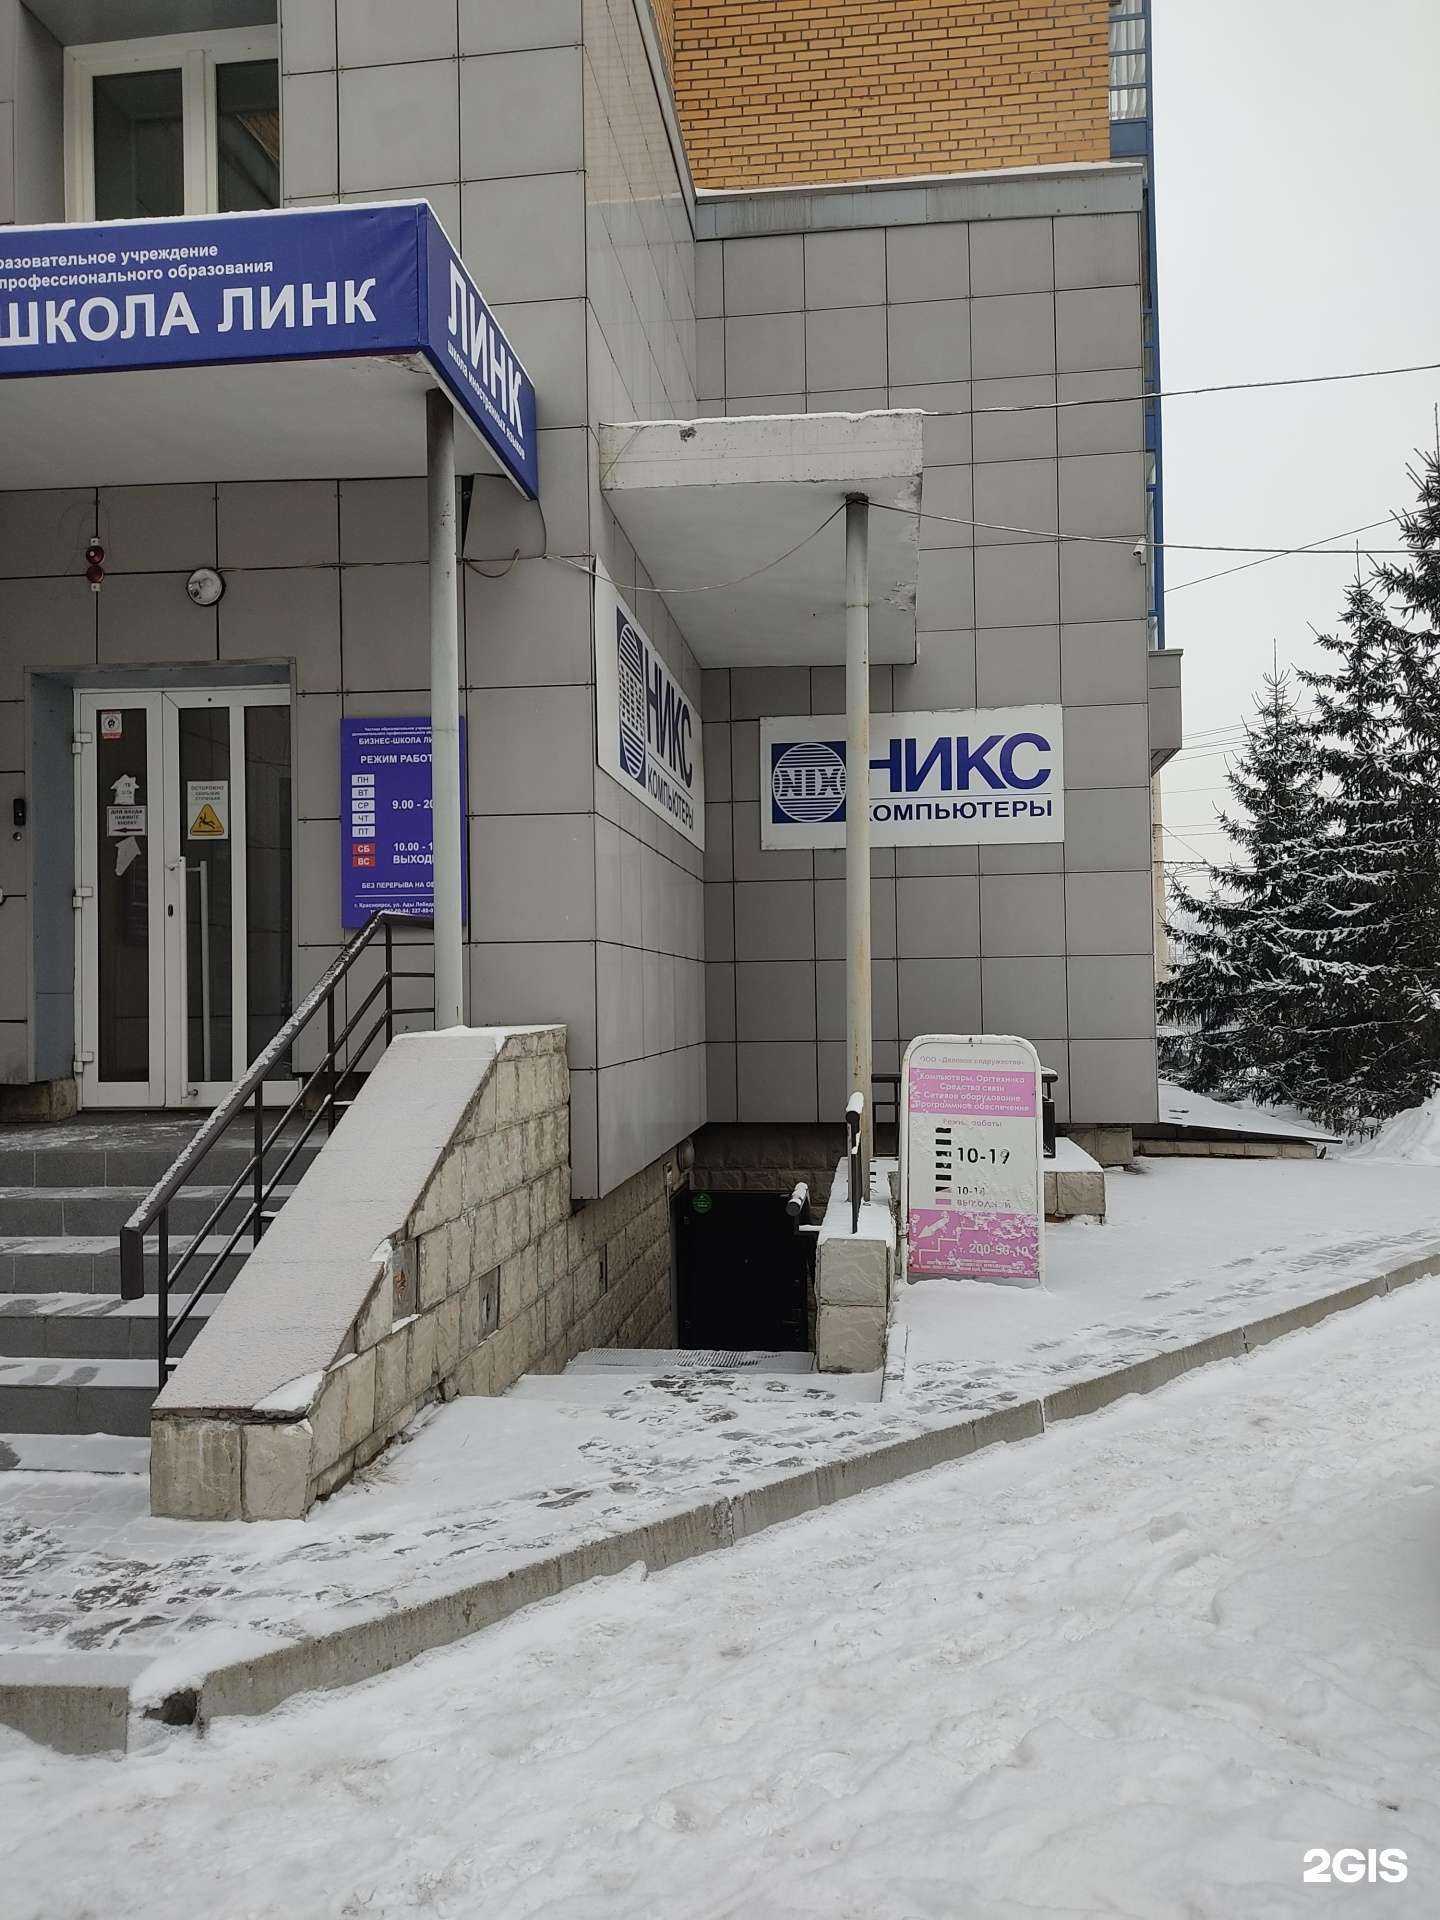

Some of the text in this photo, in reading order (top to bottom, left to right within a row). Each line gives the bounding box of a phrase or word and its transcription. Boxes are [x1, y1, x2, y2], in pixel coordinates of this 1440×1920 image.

[121, 245, 218, 265] учреждение
[0, 261, 273, 291] профессионального образования
[0, 277, 377, 345] ШКОЛА ЛИНК
[447, 339, 468, 379] школа
[448, 258, 524, 440] ЛИНК
[644, 646, 693, 789] НИКС
[358, 736, 432, 745] БИЗНЕС-ШКОЛА ЛИ
[360, 754, 432, 764] РЕЖИМ РАБОТ
[869, 732, 1051, 792] НИКС
[357, 776, 369, 784] ПН
[358, 789, 369, 797] ВТ
[647, 763, 694, 832] КОМПЬЮТЕРЫ
[392, 800, 414, 809] 9.00
[423, 800, 433, 809] 20
[869, 799, 1052, 822] ОМПЬЮТЕРЫ
[357, 845, 370, 853] СБ
[393, 842, 419, 852] 10.00
[393, 855, 433, 865] ВЫХОД
[376, 881, 414, 889] ПЕРЕРЫВА
